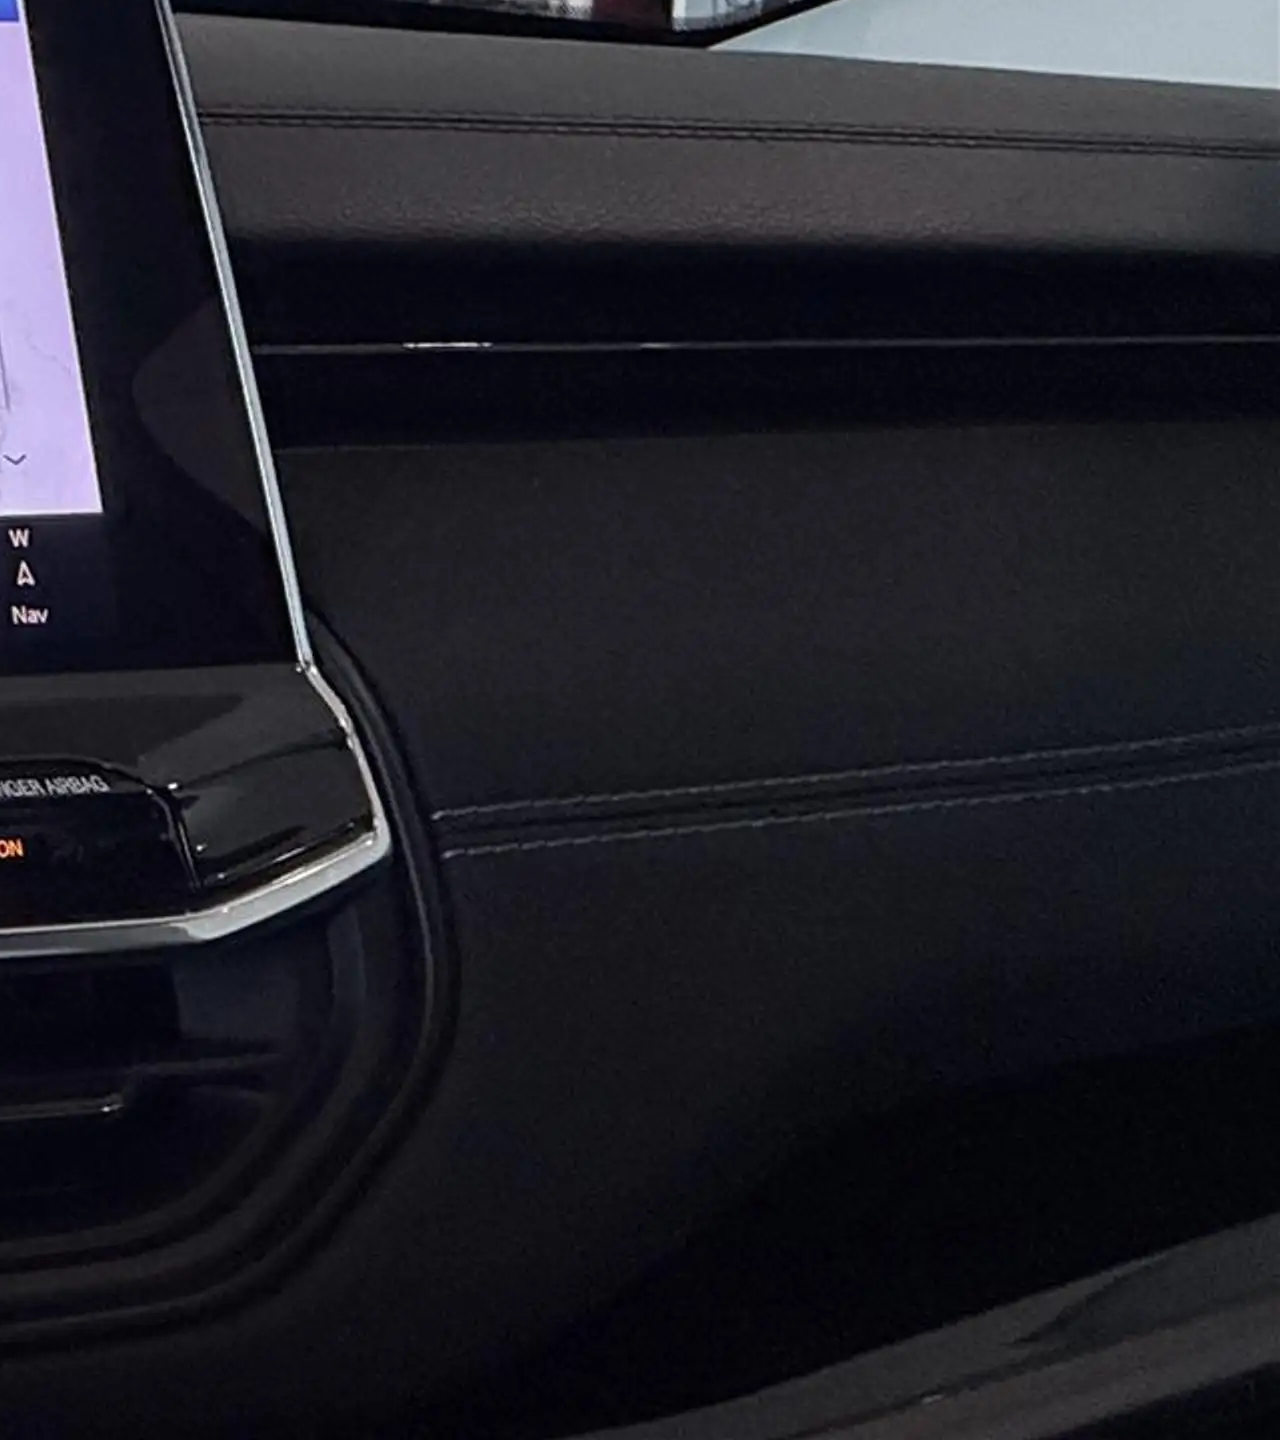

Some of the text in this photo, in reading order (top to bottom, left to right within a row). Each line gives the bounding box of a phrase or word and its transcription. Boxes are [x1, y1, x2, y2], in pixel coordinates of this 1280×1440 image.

[8, 528, 30, 548] W
[11, 605, 49, 626] Nav
[45, 774, 111, 797] AIRBAG
